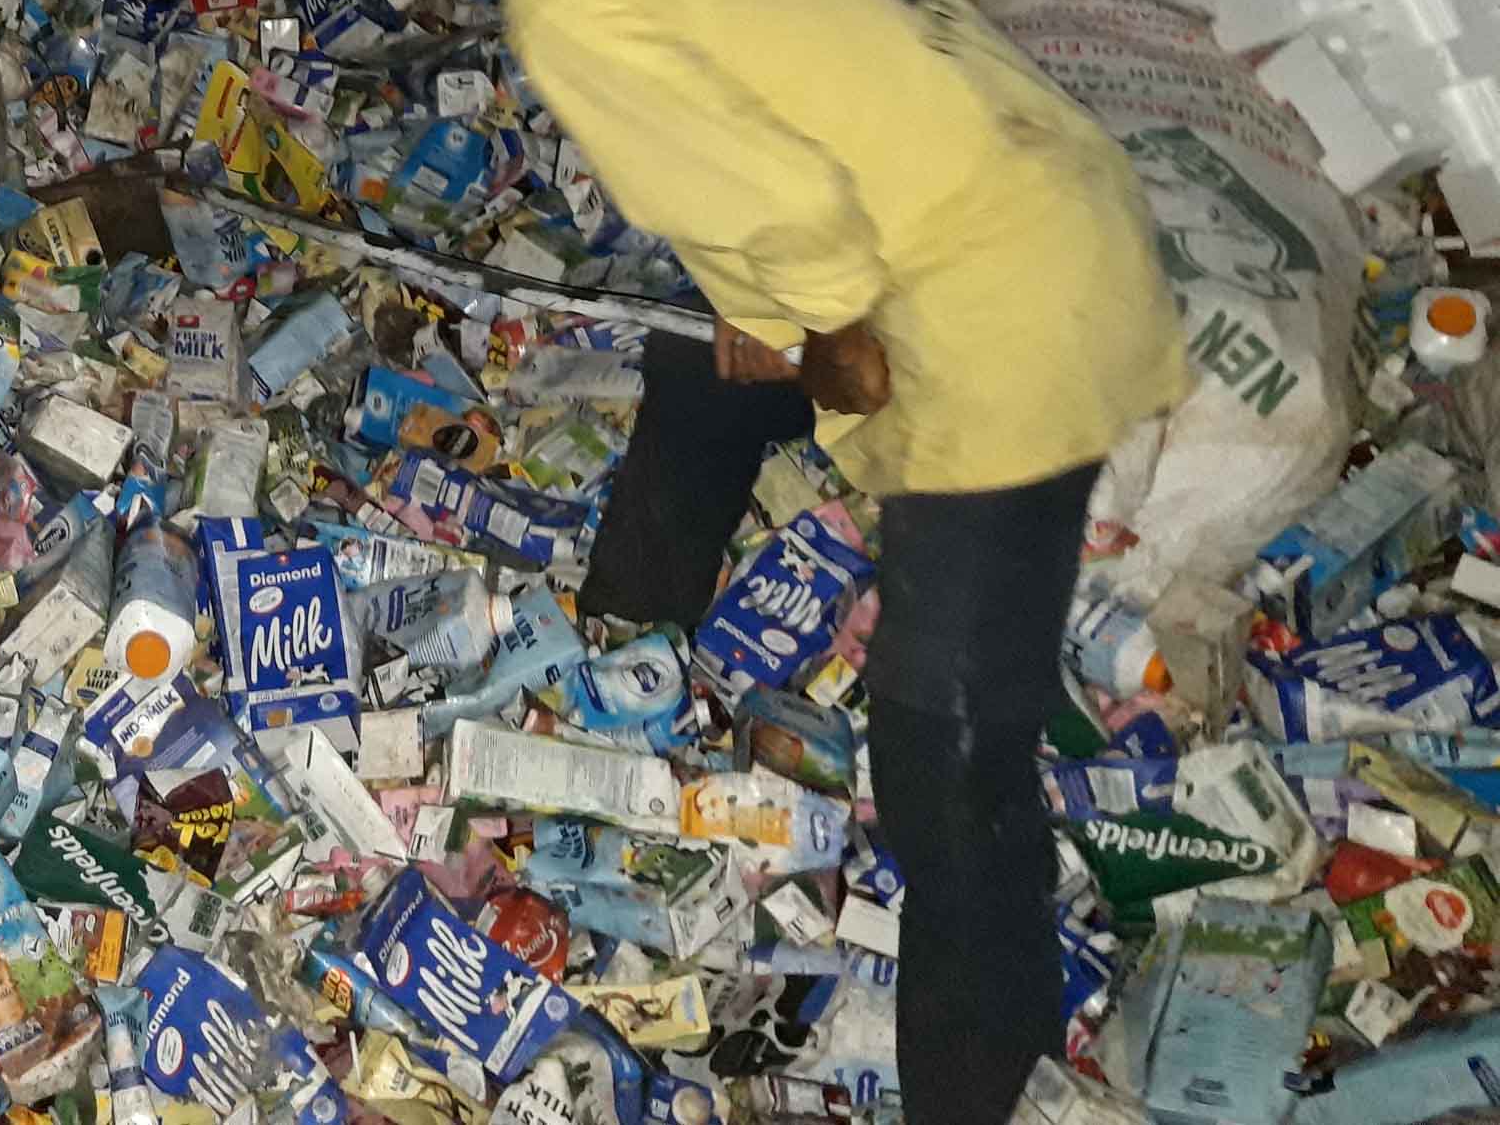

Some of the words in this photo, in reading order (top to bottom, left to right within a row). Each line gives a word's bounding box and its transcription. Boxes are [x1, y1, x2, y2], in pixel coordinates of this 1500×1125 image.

[174, 337, 225, 361] MILK
[249, 561, 323, 587] Diamond
[250, 595, 333, 685] Milk
[1085, 818, 1266, 872] Greenfields
[416, 917, 489, 1052] Milk
[526, 1082, 573, 1123] MILK
